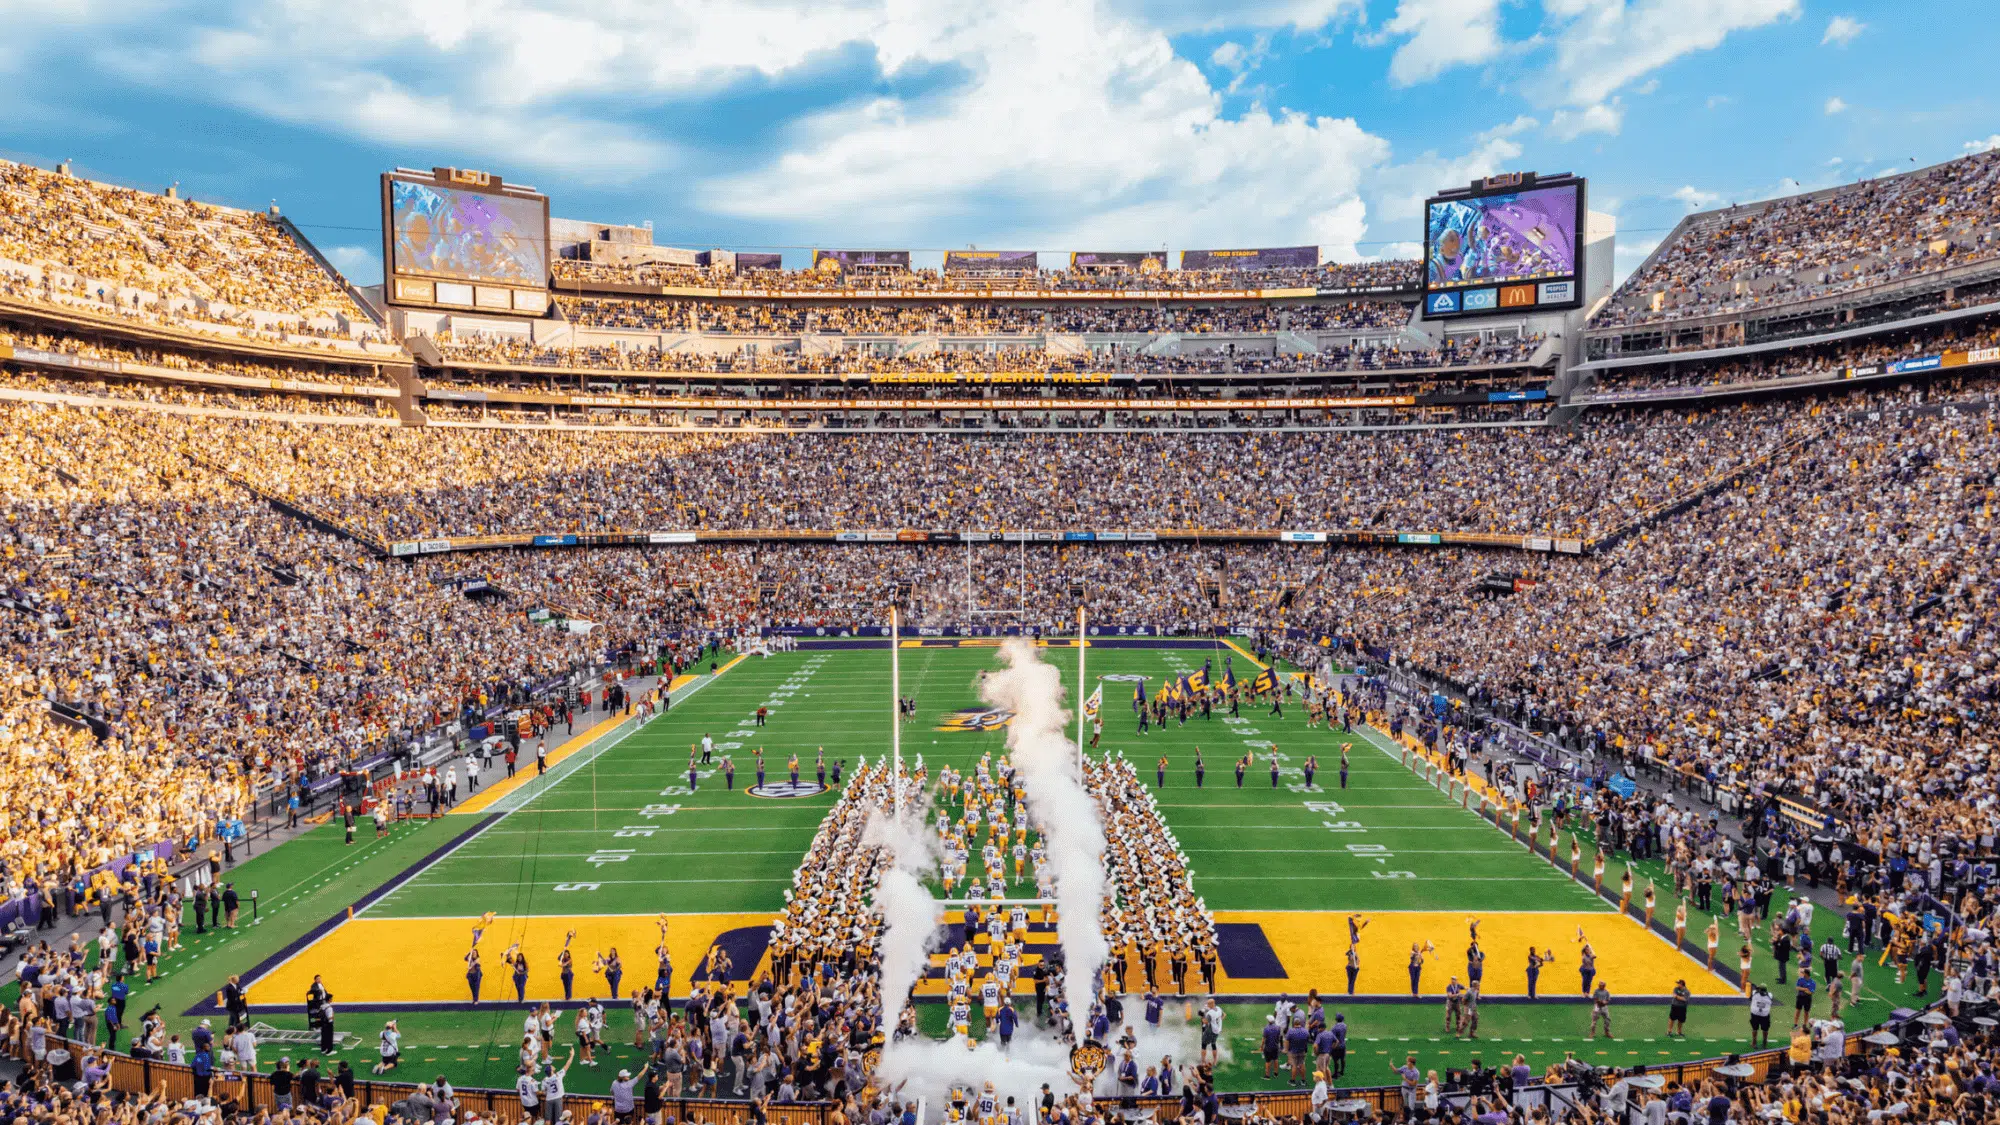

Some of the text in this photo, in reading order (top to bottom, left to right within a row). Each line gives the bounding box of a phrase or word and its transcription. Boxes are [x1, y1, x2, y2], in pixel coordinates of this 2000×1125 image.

[450, 167, 491, 187] LSU
[1483, 171, 1523, 190] LSU
[1465, 293, 1496, 306] COX
[1967, 347, 2000, 363] ORDER
[870, 373, 1112, 383] WELCOME TO DEATH VALLEY
[1188, 670, 1205, 692] E
[1255, 671, 1273, 694] S
[613, 825, 660, 837] 15
[1322, 821, 1367, 832] 15
[586, 849, 636, 862] 10
[1346, 844, 1394, 857] 10
[992, 861, 1000, 869] 42
[1371, 871, 1417, 880] 5
[553, 882, 601, 891] 5
[991, 883, 1000, 891] 79
[972, 889, 980, 897] 26
[1013, 913, 1023, 921] 77
[992, 925, 999, 934] 71
[965, 955, 974, 964] 47
[950, 961, 960, 969] 14
[999, 964, 1009, 974] 33
[954, 985, 965, 994] 40
[985, 988, 997, 997] 68
[955, 1010, 967, 1020] 82
[171, 1052, 178, 1062] 9
[521, 1083, 528, 1096] 9
[550, 1083, 558, 1093] 3
[980, 1100, 993, 1112] 49
